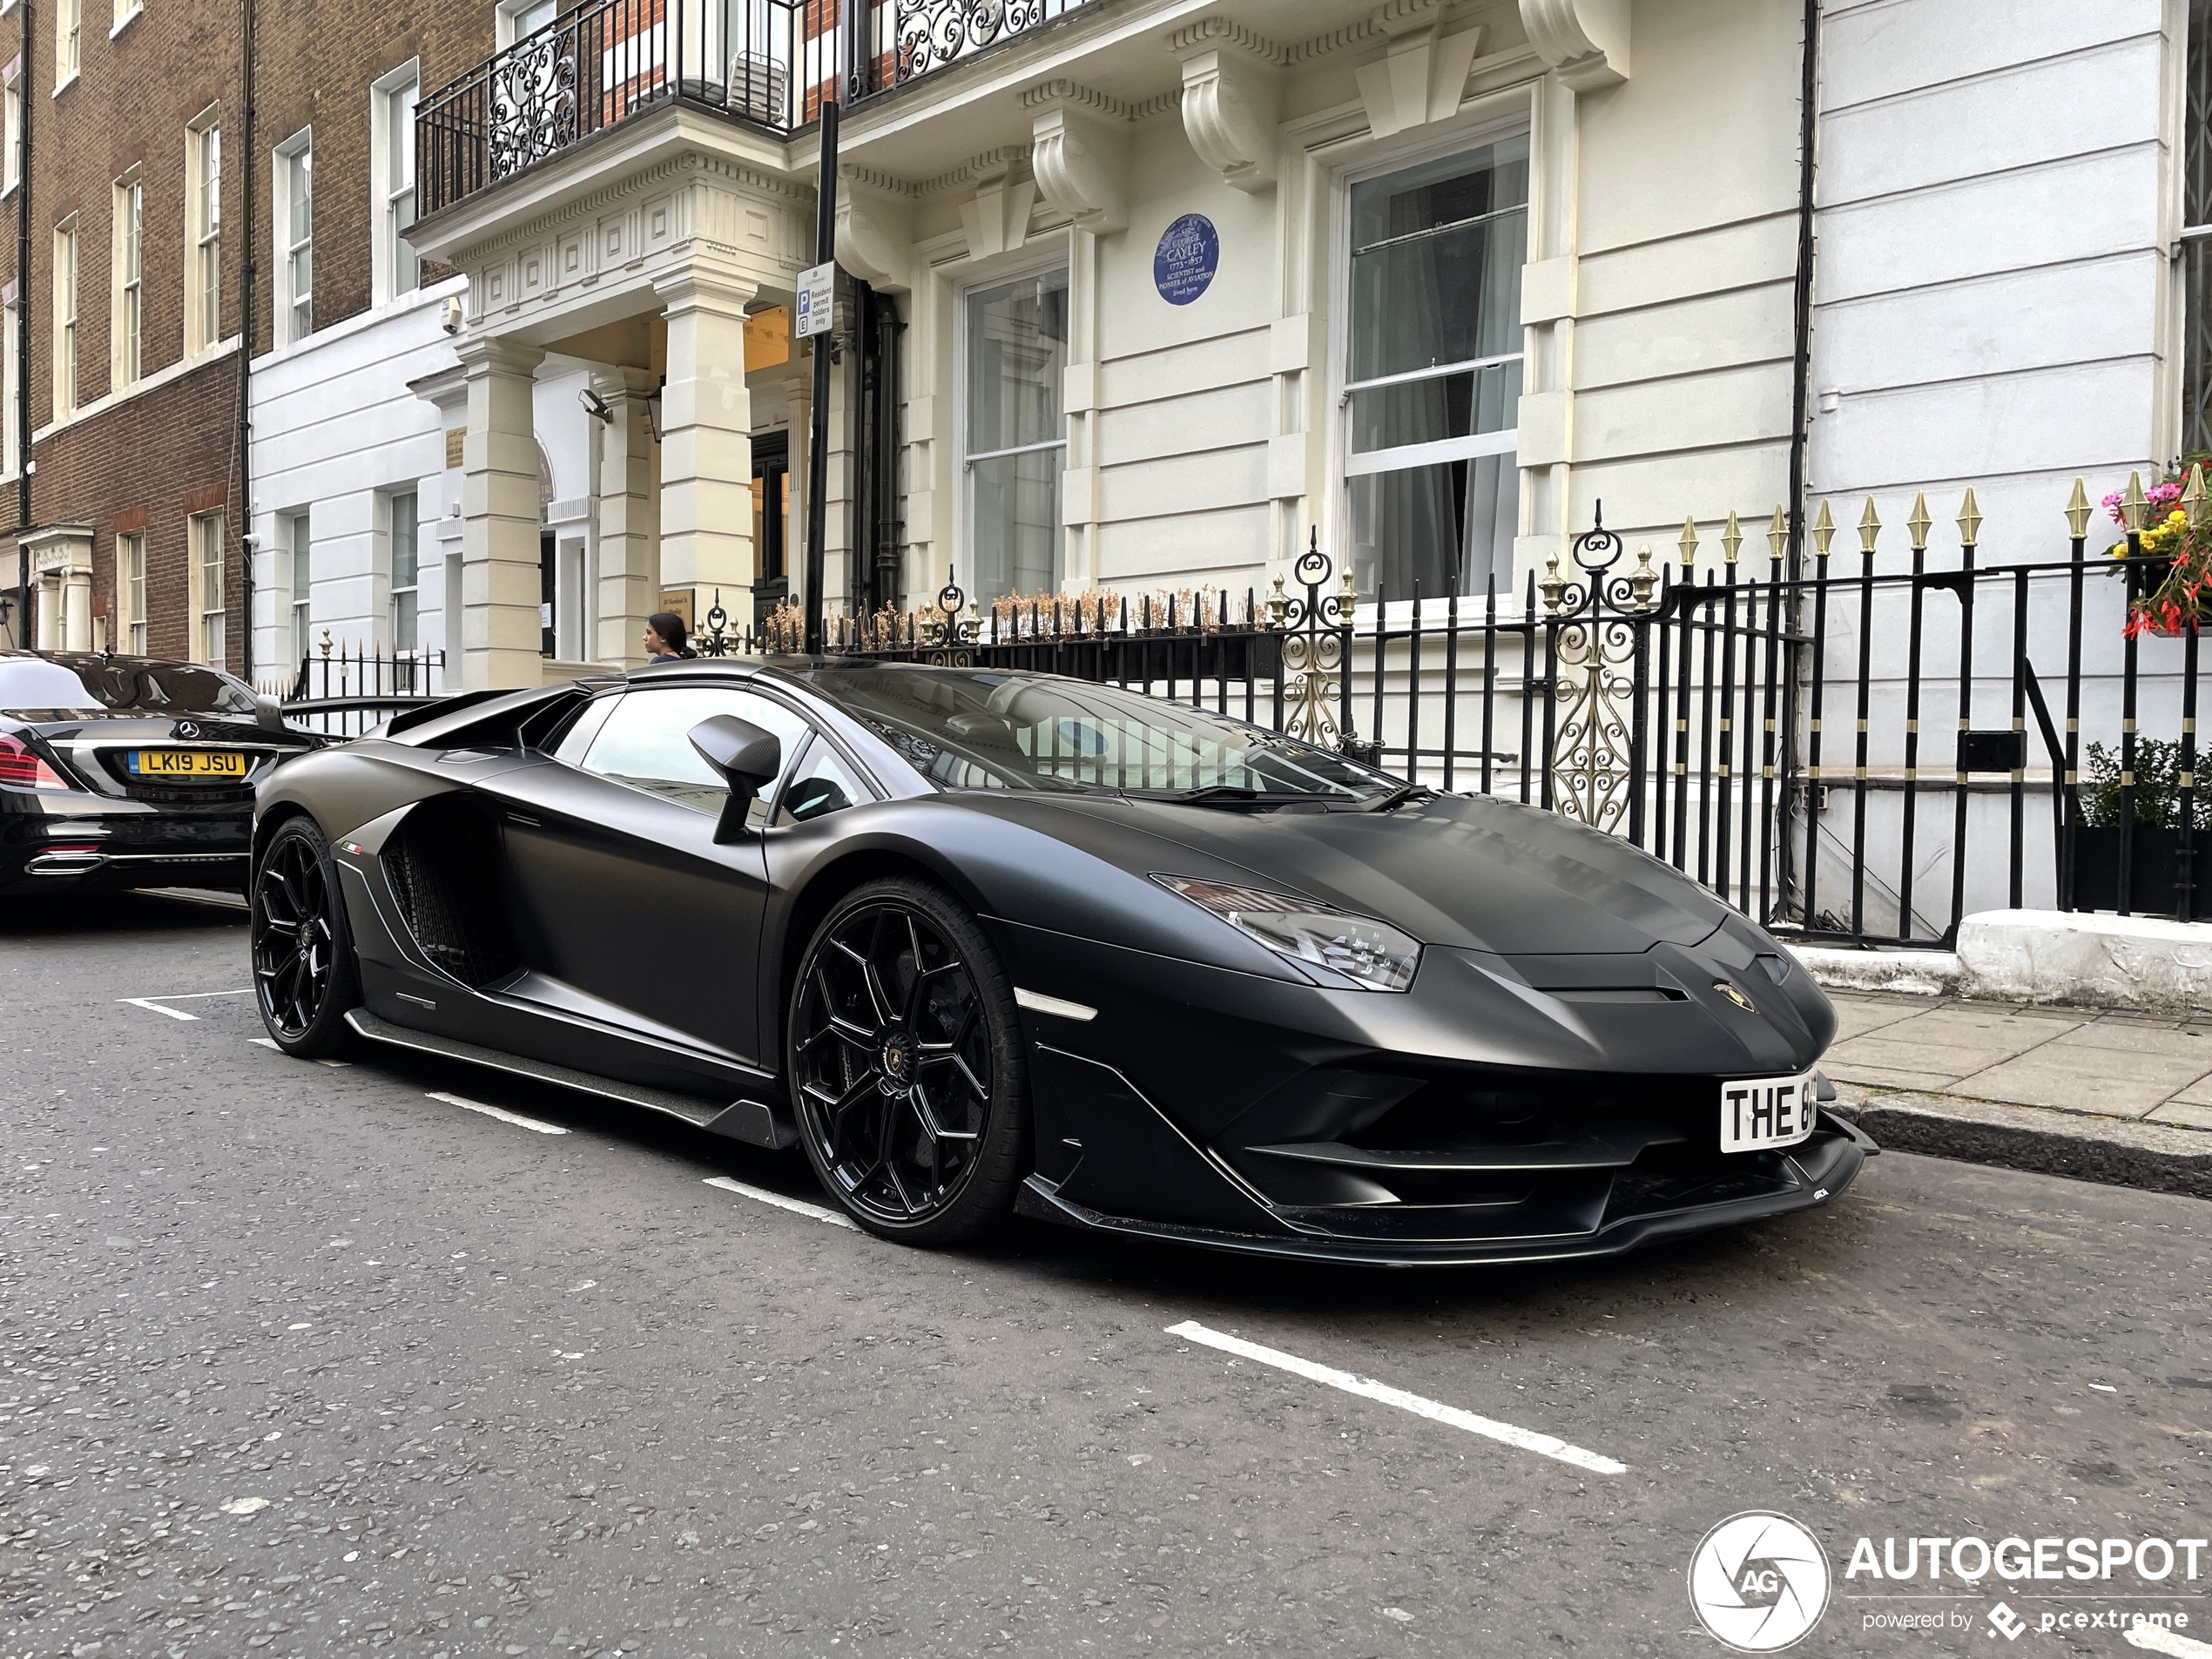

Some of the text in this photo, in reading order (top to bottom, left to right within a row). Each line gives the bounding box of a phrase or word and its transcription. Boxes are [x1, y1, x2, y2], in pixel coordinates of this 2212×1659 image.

[1171, 233, 1200, 248] GEORGE
[1166, 242, 1204, 261] CAYLEY
[1166, 267, 1195, 280] SCIENTIST
[1158, 279, 1181, 290] PIONEER
[1187, 271, 1214, 283] AVIATION
[811, 286, 832, 299] Resident
[1173, 286, 1198, 296] lived here
[800, 293, 808, 313] P
[813, 297, 829, 308] permit
[812, 307, 830, 317] holders
[801, 320, 806, 329] E
[815, 316, 826, 325] only
[762, 606, 772, 617] 20
[147, 753, 237, 772] LK19 JSU
[1726, 1085, 1795, 1142] THE
